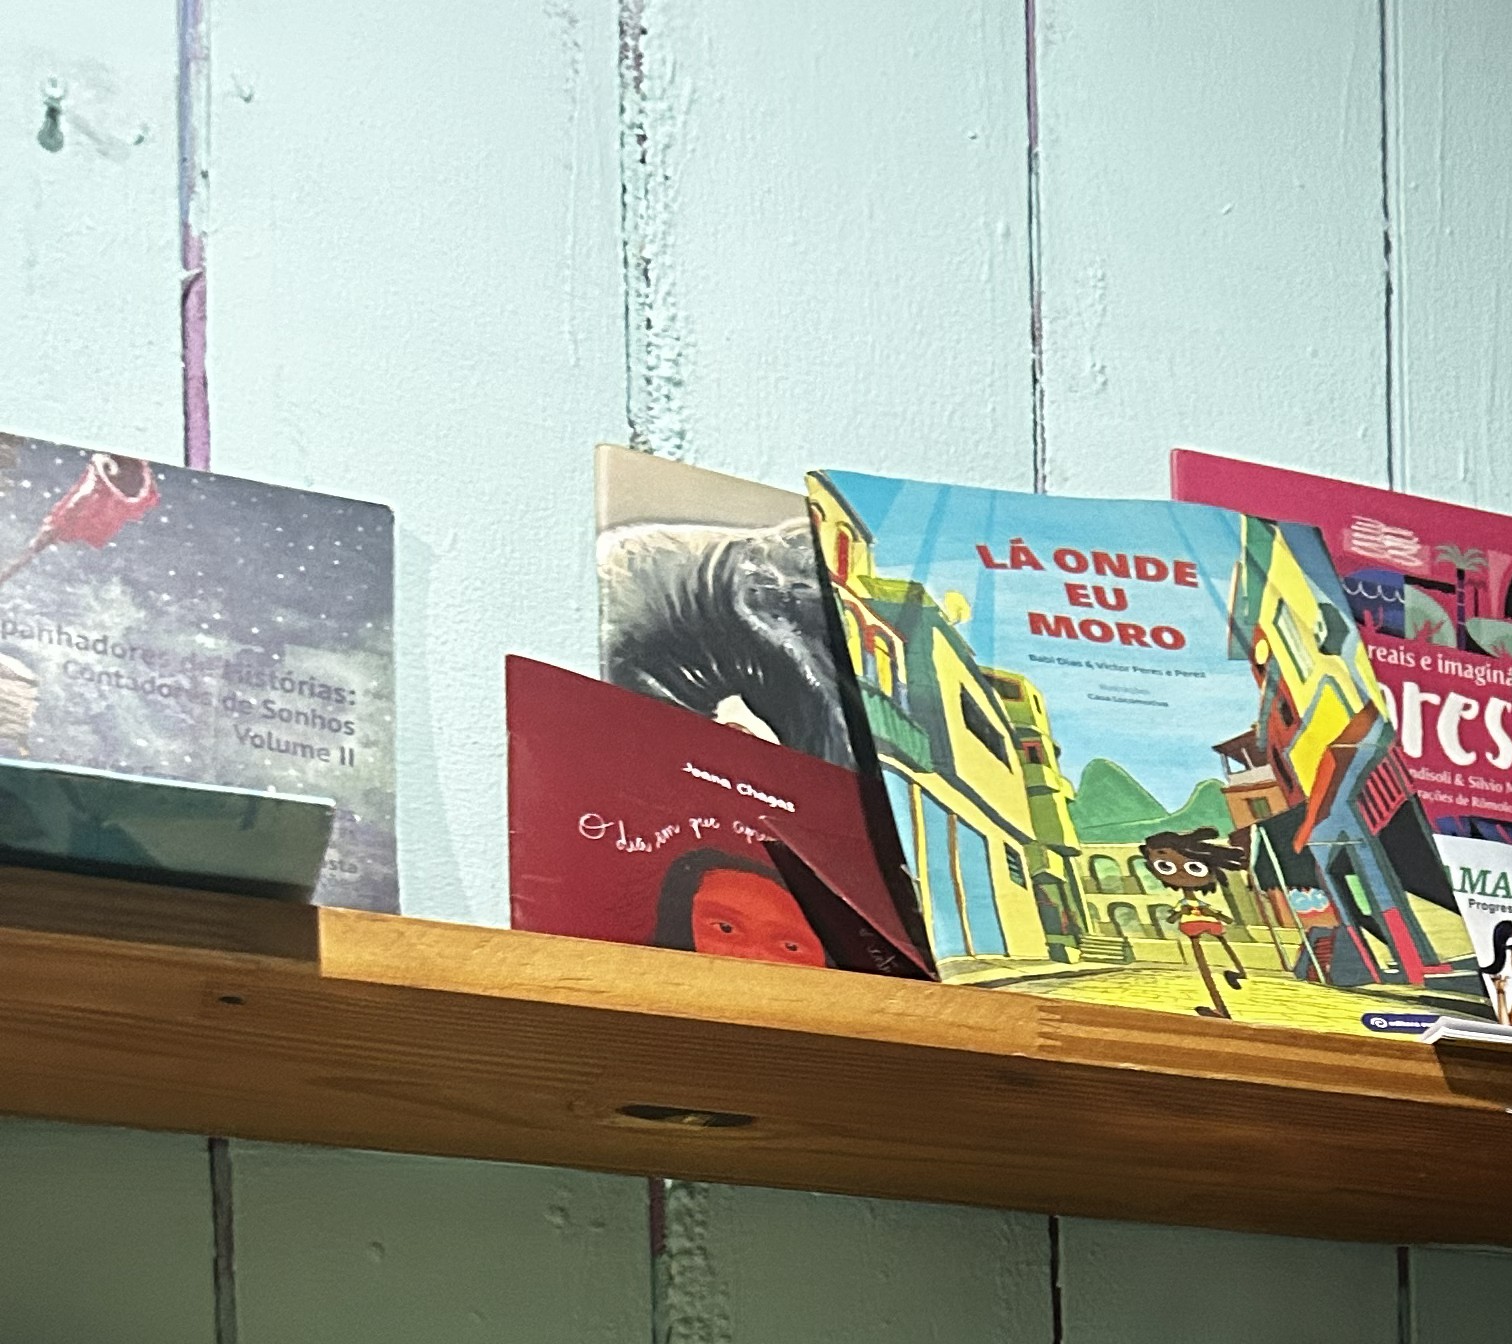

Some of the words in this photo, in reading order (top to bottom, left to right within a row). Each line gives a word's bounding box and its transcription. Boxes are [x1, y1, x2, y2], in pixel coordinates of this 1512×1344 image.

[976, 537, 1046, 571] LÁ
[1053, 547, 1199, 588] ONDE
[1064, 582, 1128, 612] EU
[1028, 611, 1186, 650] MORO
[1368, 644, 1415, 668] reais
[1420, 655, 1433, 671] e
[262, 700, 356, 736] Sonhos
[234, 724, 331, 763] Volume
[579, 813, 614, 840] O
